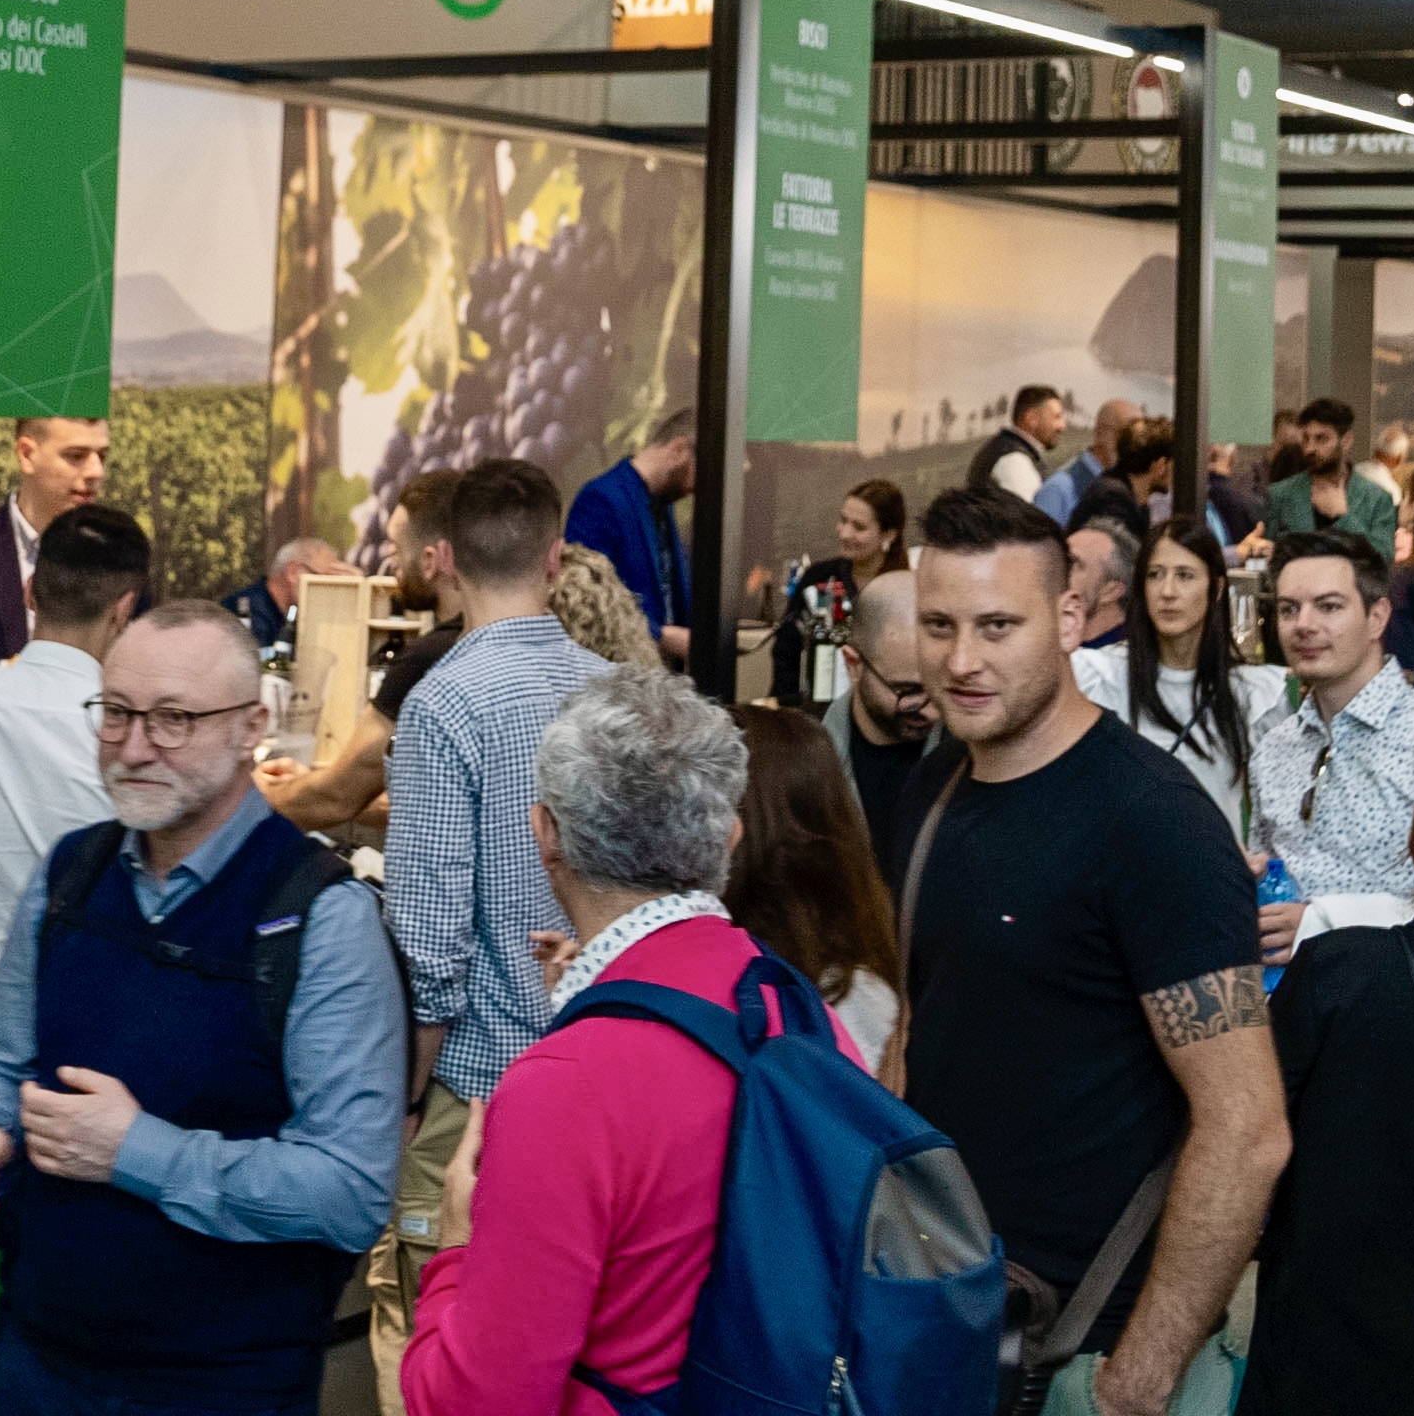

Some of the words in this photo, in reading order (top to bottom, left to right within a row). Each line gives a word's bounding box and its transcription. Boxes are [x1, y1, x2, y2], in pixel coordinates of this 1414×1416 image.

[6, 12, 32, 42] dei
[34, 15, 88, 50] Castelli
[14, 45, 48, 77] DOC
